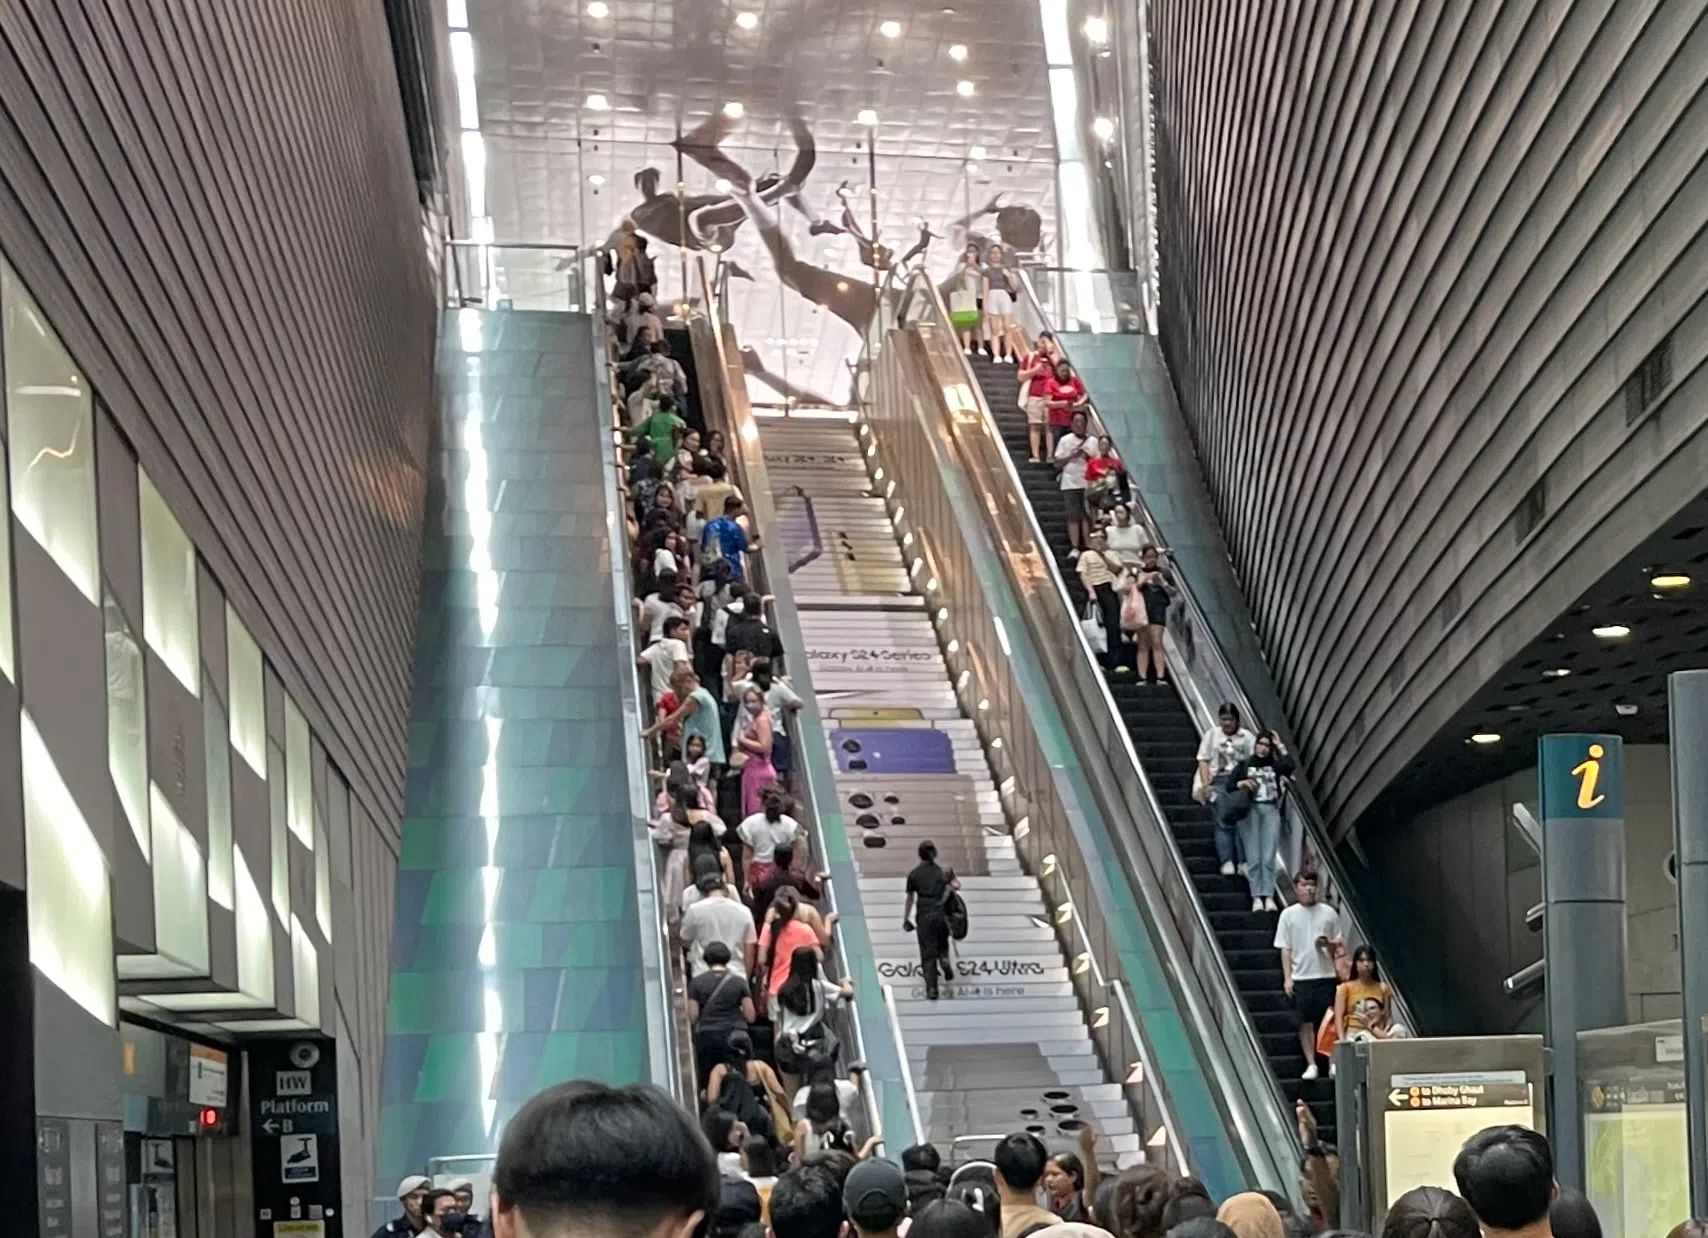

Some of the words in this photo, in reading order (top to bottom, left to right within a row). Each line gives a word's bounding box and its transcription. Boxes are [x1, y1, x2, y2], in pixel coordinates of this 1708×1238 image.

[805, 649, 848, 663] alaxy
[956, 960, 990, 976] S24
[994, 960, 1044, 976] Ultra
[261, 1098, 329, 1115] Platform
[282, 1118, 293, 1133] B
